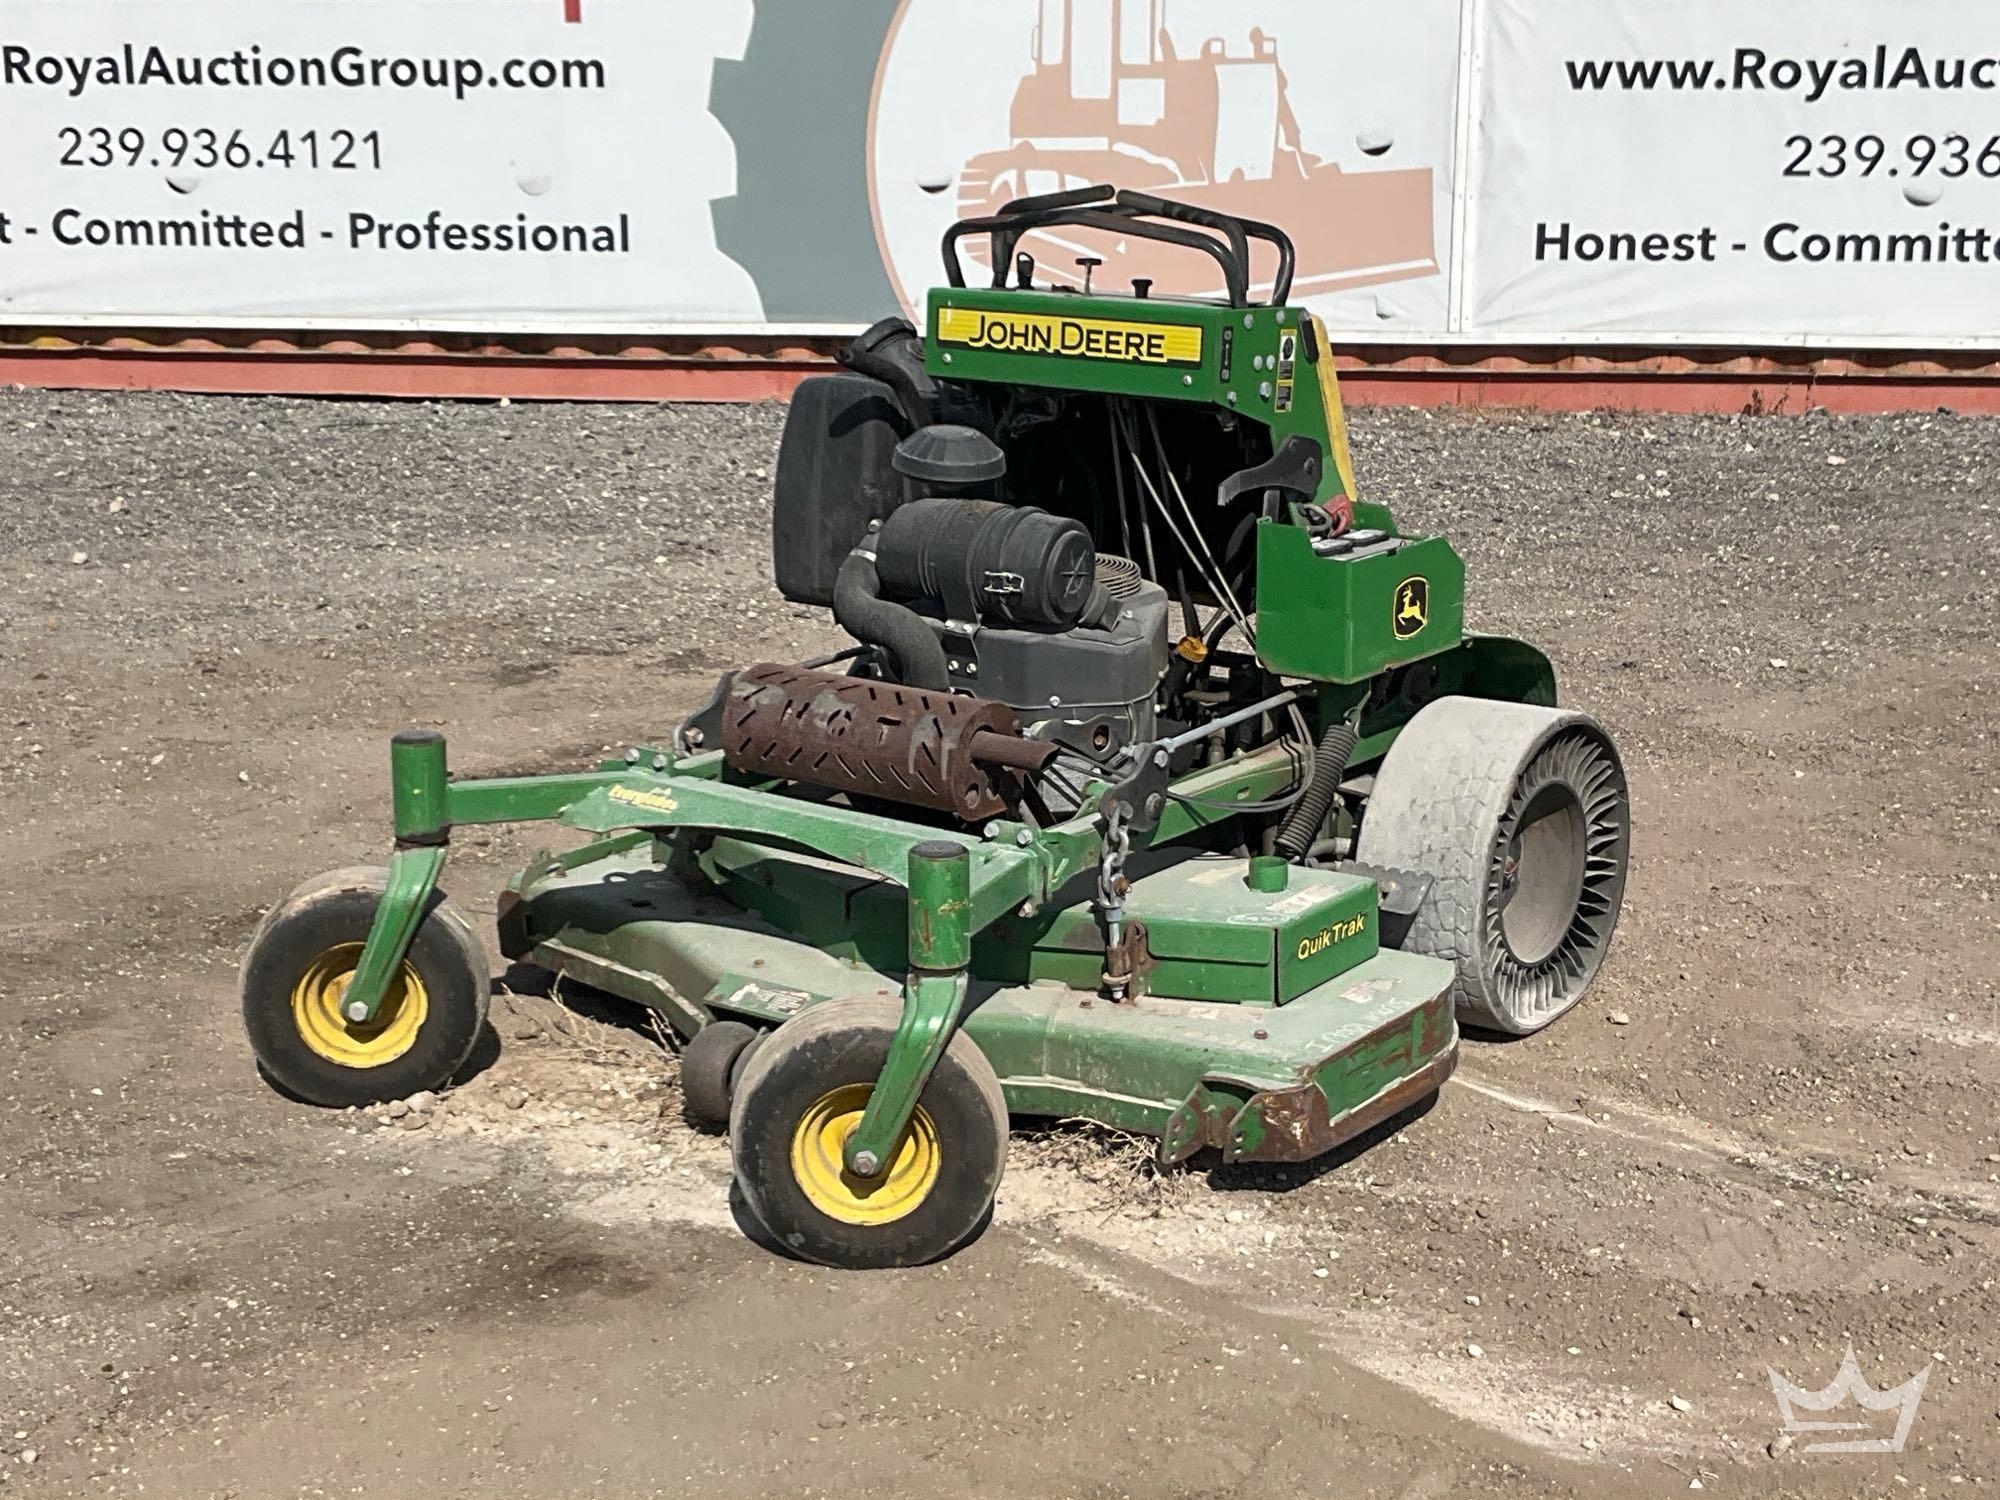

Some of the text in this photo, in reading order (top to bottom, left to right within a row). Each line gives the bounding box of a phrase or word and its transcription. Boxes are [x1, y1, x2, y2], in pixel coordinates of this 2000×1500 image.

[2, 43, 605, 99] RoyalAuctionGroup.com
[1565, 44, 2000, 103] www.RoyalAuc
[58, 126, 381, 170] 239.936.4121
[52, 208, 305, 248] Committed
[349, 210, 629, 253] Professional
[1535, 222, 1717, 262] Honest
[968, 314, 1166, 359] JOHN DEERE
[1297, 912, 1366, 960] QuikTrak
